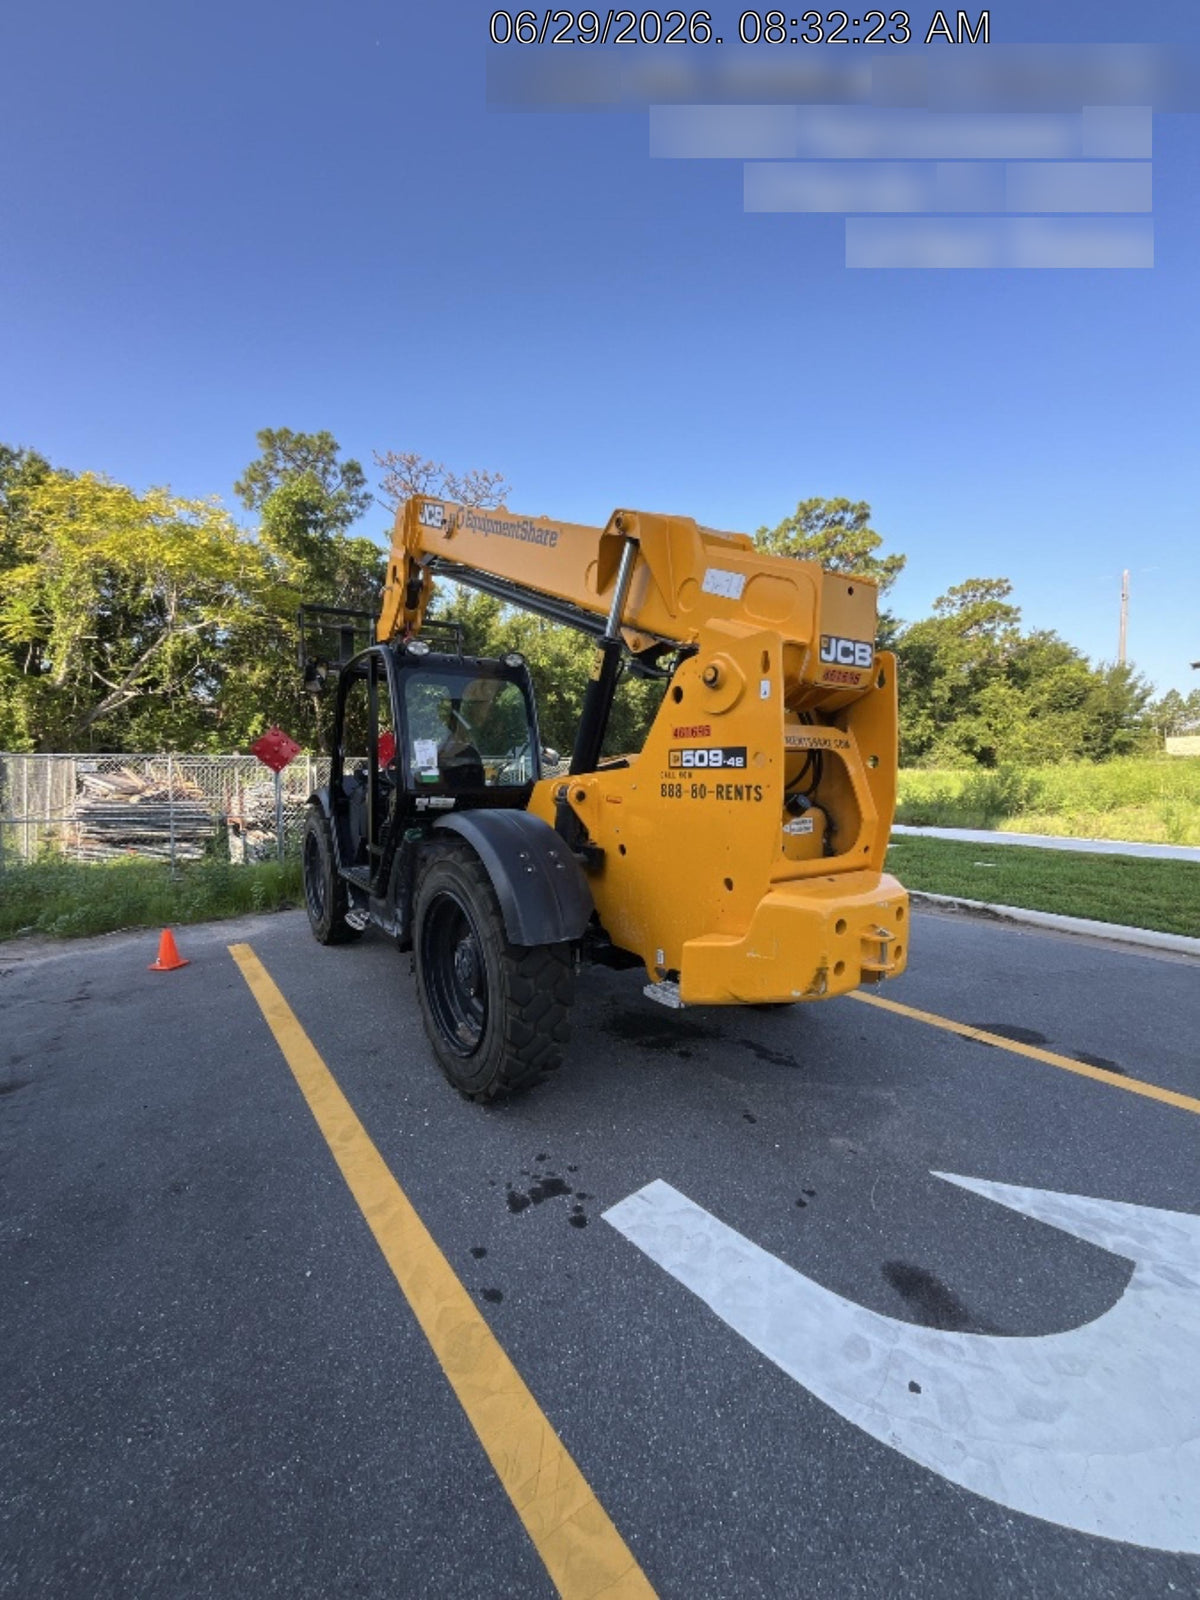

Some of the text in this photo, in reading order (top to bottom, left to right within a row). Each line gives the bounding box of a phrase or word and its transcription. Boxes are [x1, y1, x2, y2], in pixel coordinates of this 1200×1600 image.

[419, 503, 443, 527] JCB
[466, 510, 558, 547] EquipmentShare
[821, 637, 872, 667] JCB
[660, 783, 763, 802] 888-80-RENTS
